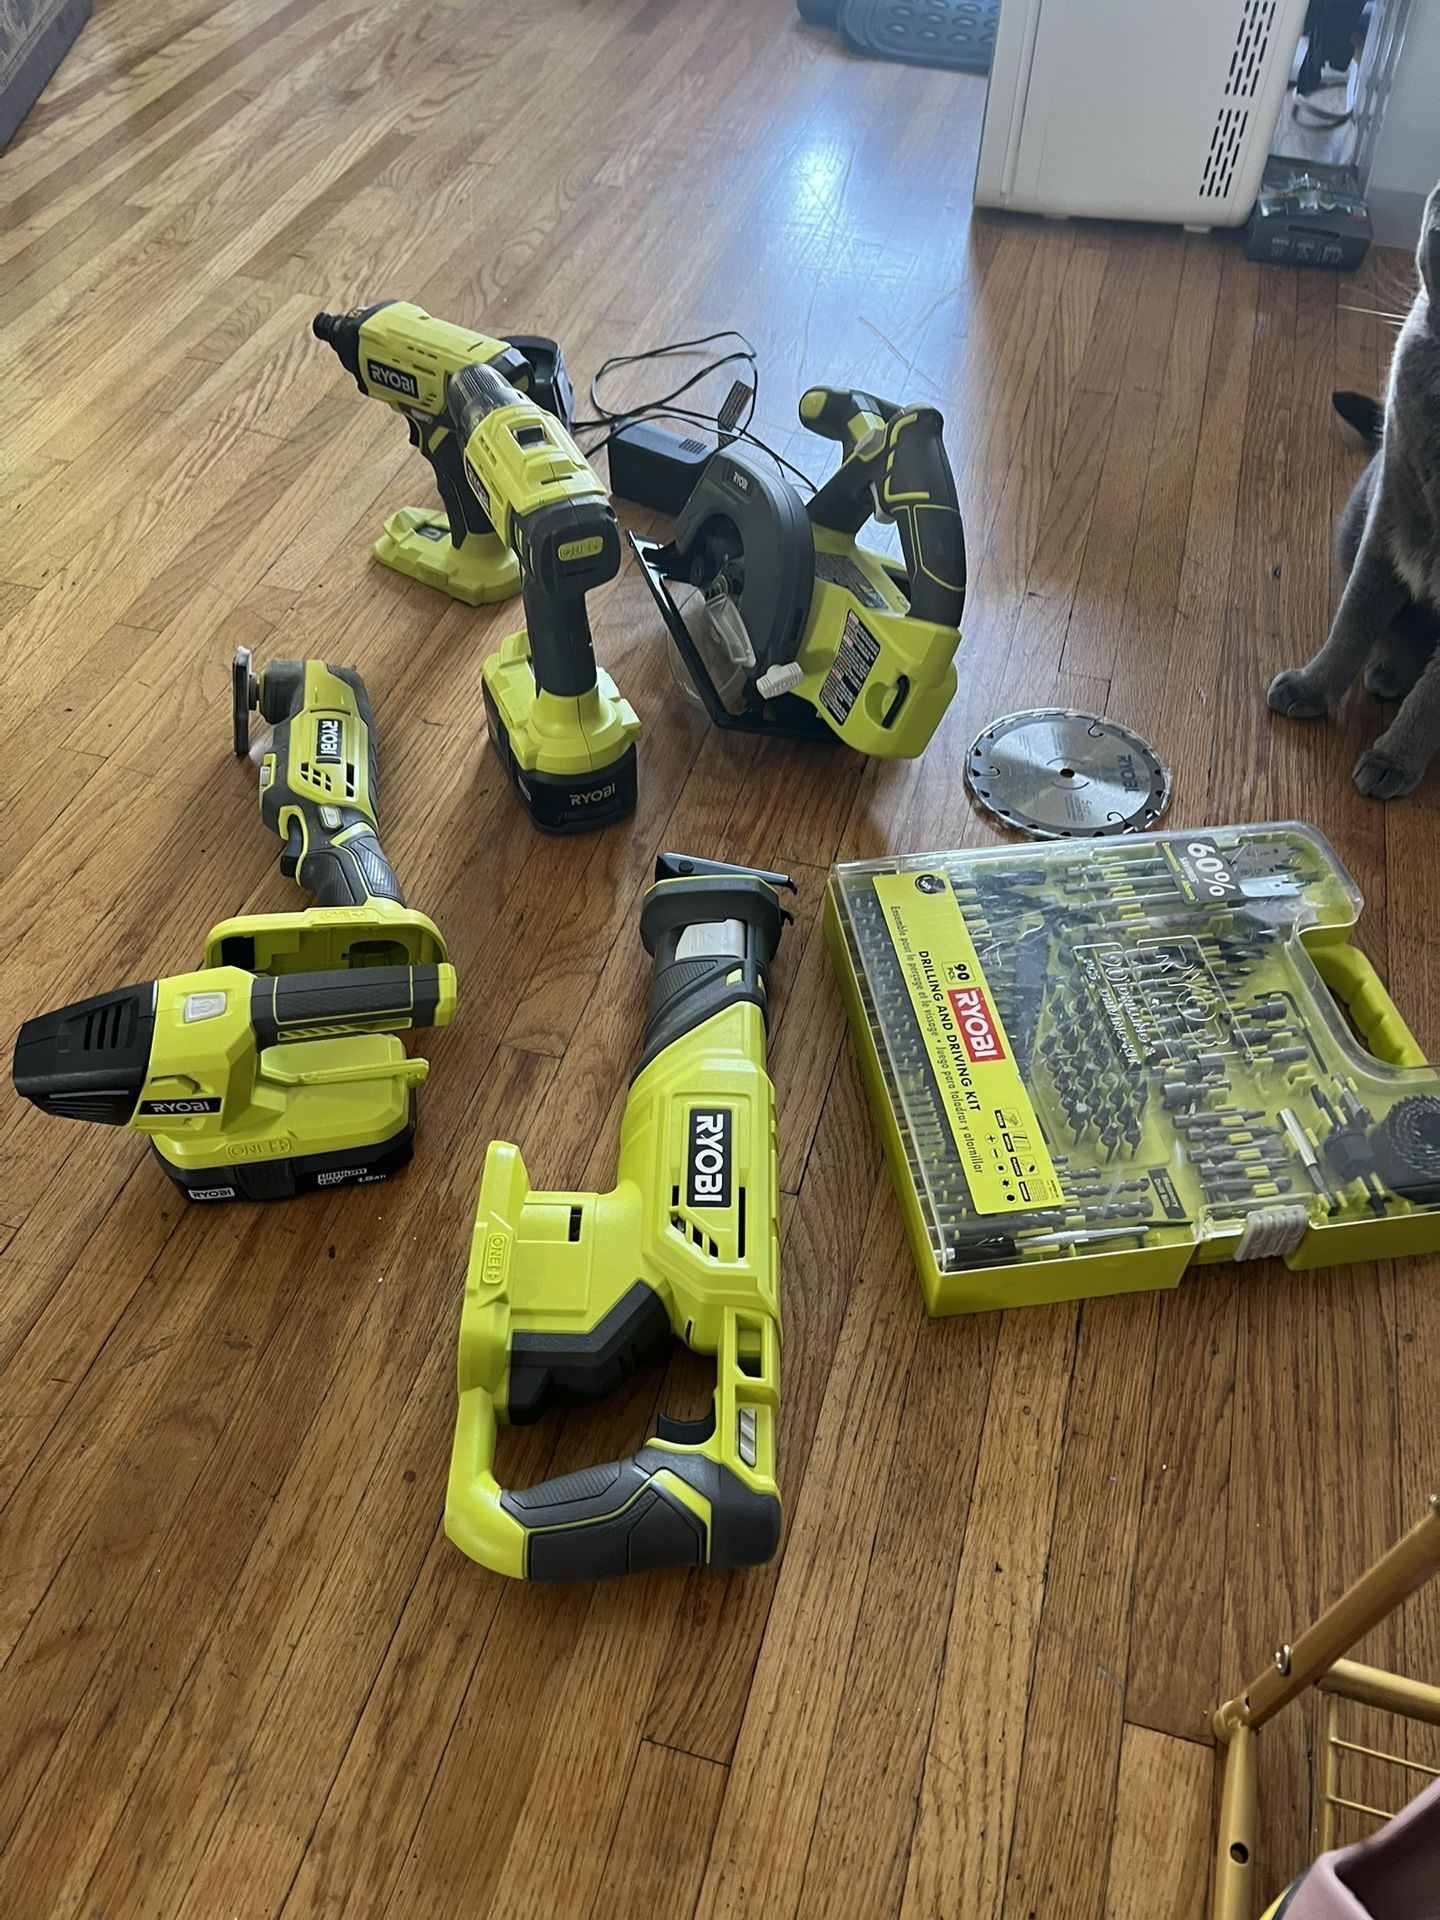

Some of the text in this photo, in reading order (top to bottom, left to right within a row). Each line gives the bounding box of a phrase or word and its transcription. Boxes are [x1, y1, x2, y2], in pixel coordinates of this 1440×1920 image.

[370, 364, 416, 394] RYOBI
[733, 471, 748, 490] RYOBI
[320, 720, 338, 755] RYOBI
[1117, 755, 1140, 793] RYOBI
[569, 782, 616, 806] RYOBI
[1187, 842, 1236, 897] 60%
[891, 906, 908, 936] Ensemble
[900, 938, 911, 953] pour
[906, 953, 916, 961] le
[907, 963, 923, 990] perçage
[954, 964, 970, 981] 90
[925, 1009, 939, 1036] vissage
[955, 990, 998, 1058] RYOBI
[1100, 988, 1130, 1040] DRIVING
[918, 951, 981, 1111] DRILLING AND DRIVING KIT
[936, 1046, 949, 1069] Juego
[942, 1071, 955, 1089] para
[150, 1101, 210, 1113] RYOBI
[950, 1090, 967, 1125] taladrar
[695, 1114, 724, 1202] RYOBI
[964, 1133, 984, 1173] atornillar
[190, 1188, 233, 1199] RYOBI
[487, 1236, 503, 1279] ONE+
